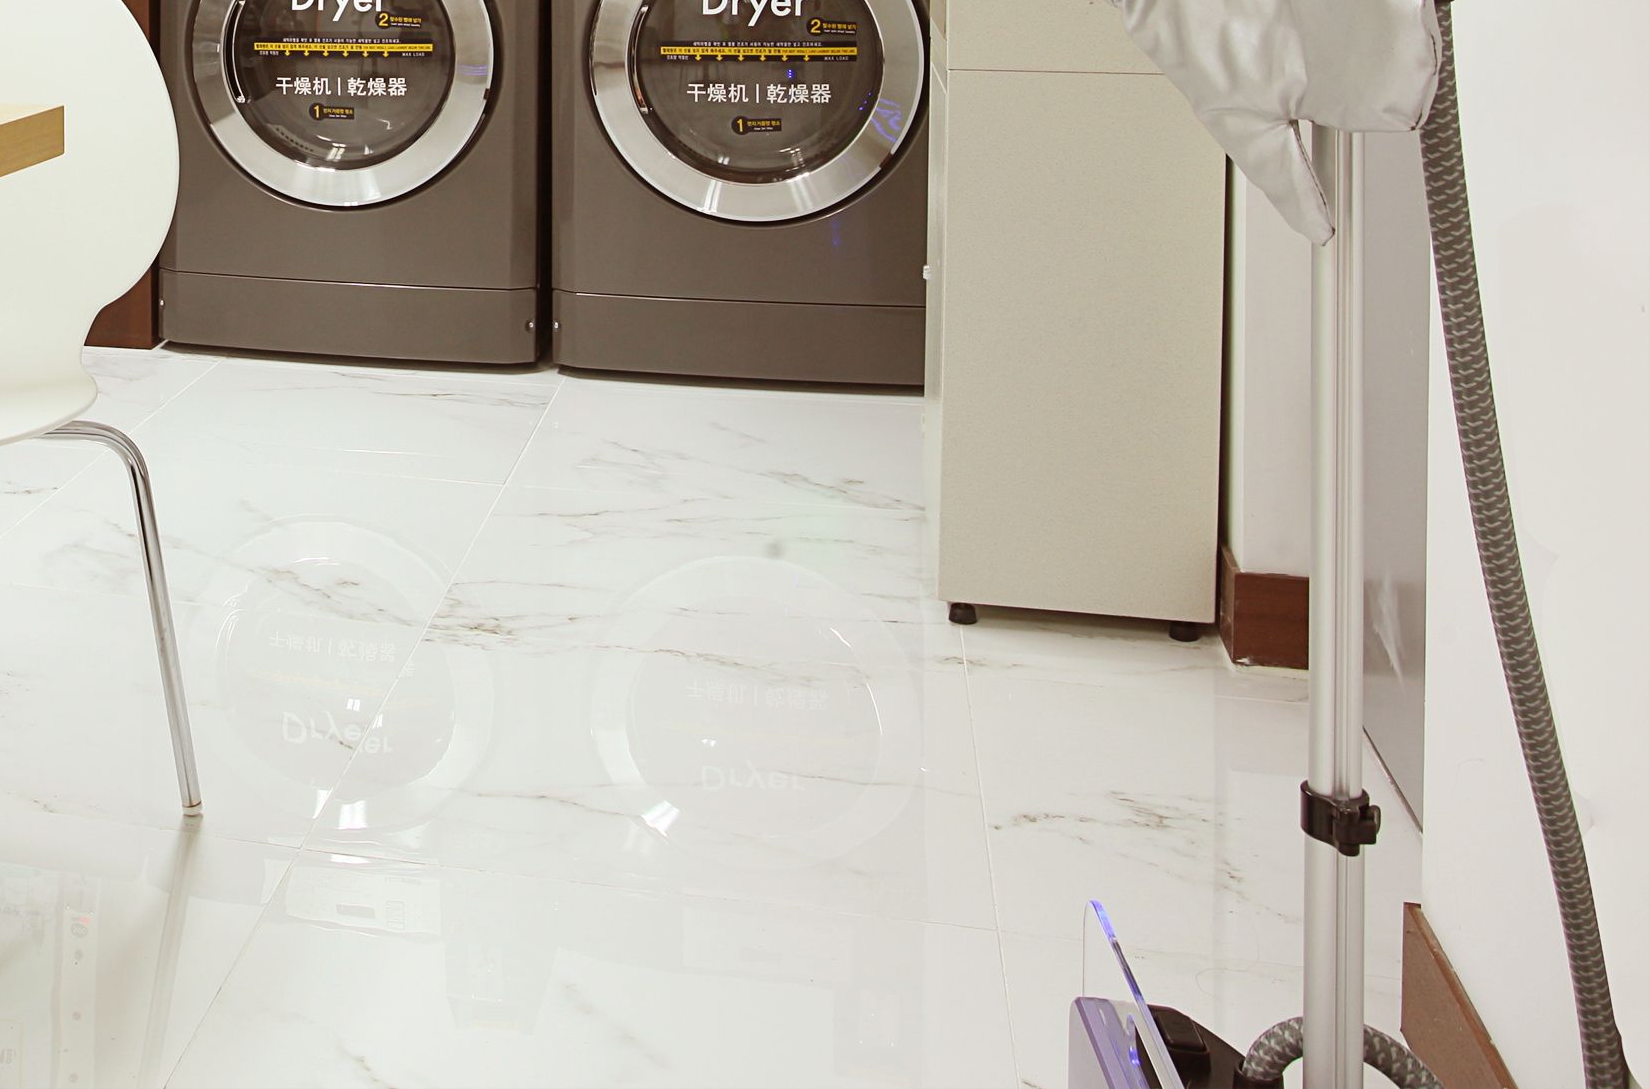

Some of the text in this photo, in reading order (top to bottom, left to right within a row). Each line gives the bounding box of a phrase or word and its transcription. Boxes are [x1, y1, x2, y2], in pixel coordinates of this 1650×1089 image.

[379, 13, 388, 26] 2
[811, 19, 821, 33] 2
[276, 77, 407, 96] 干燥机 乾燥器
[687, 84, 831, 103] 干燥机 乾燥器
[314, 105, 320, 118] 1
[737, 119, 743, 132] 1
